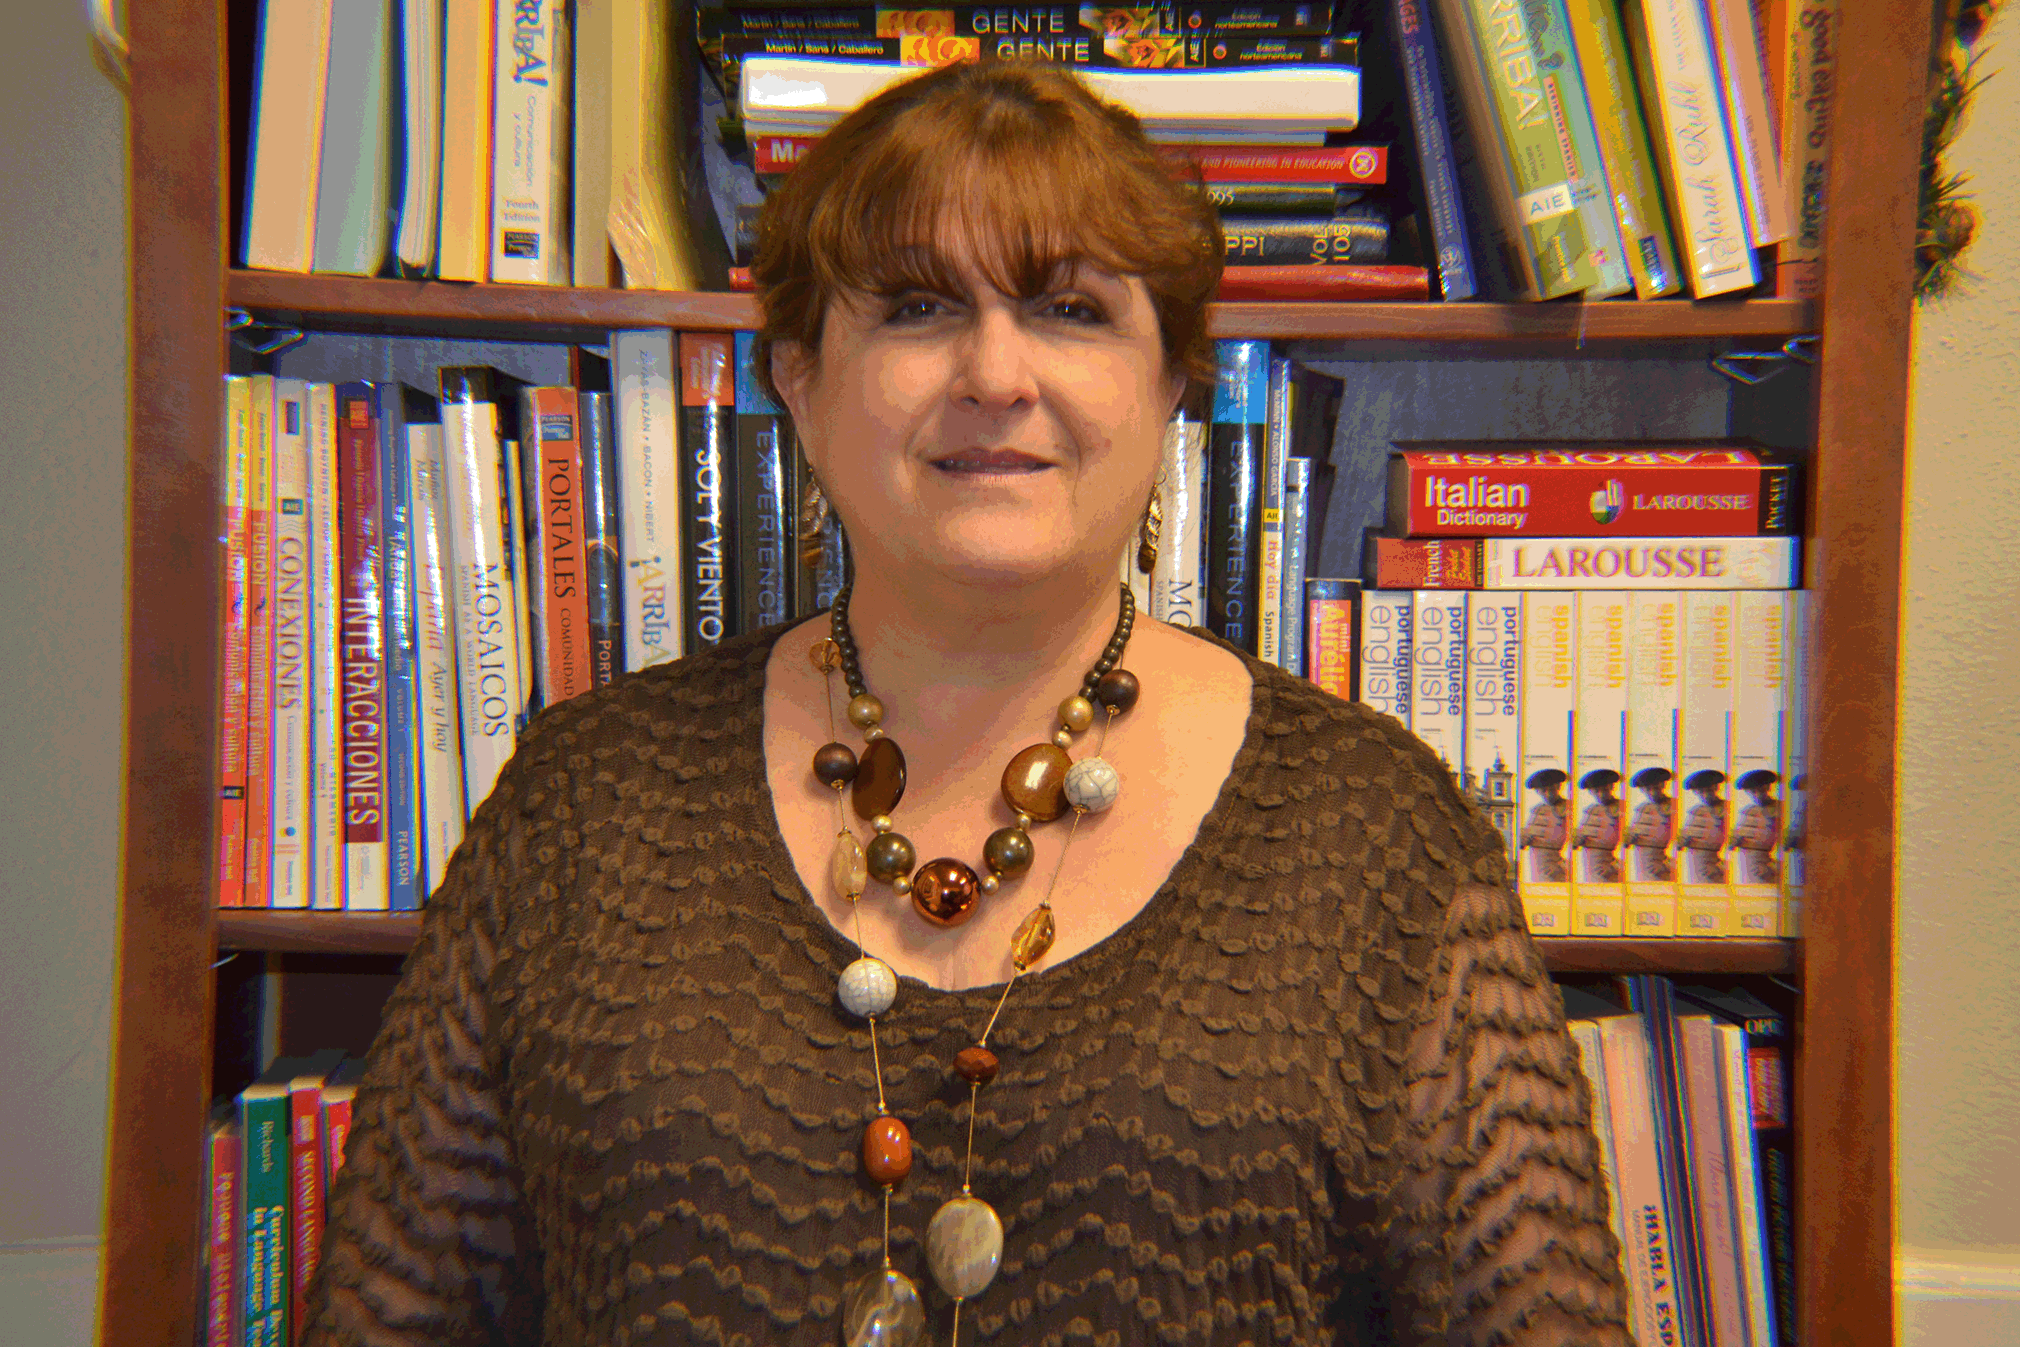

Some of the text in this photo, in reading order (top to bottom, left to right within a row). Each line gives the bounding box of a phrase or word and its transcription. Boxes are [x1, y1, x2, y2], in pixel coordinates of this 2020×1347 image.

[837, 42, 884, 55] Caballero
[972, 11, 1065, 34] GENTE
[996, 39, 1089, 62] GENTE
[1239, 50, 1303, 61] norteamericana
[1293, 157, 1345, 171] EDUCATION
[503, 211, 541, 224] Edition
[505, 199, 540, 211] Fourth
[1530, 193, 1565, 216] AIE
[695, 449, 722, 504] SOL
[1424, 475, 1529, 508] Italian
[1632, 494, 1750, 512] LAROUSSE
[1765, 475, 1784, 530] POCKET
[547, 458, 576, 599] PORTALES
[644, 500, 655, 543] NIBERT
[755, 430, 777, 628] EXPERIENCE
[1224, 439, 1249, 640] EXPERIENCE
[1437, 508, 1527, 531] Dictionary
[1264, 540, 1279, 570] Hoy
[1422, 540, 1442, 588] French
[1511, 547, 1726, 579] LAROUSSE
[697, 536, 724, 641] VIENTO
[1287, 564, 1299, 615] Language
[275, 536, 304, 711] CONEXIONES
[472, 562, 510, 738] MOSAICOS
[1262, 610, 1275, 659] Spanish
[1340, 623, 1351, 653] mini
[1548, 604, 1569, 689] spanish
[1601, 604, 1622, 689] spanish
[1654, 602, 1675, 687] spanish
[559, 607, 575, 697] COMUNIDAD
[1362, 604, 1397, 713] english
[1392, 605, 1412, 715] portuguese
[1414, 606, 1449, 717] english
[1445, 606, 1465, 716] portuguese
[1469, 606, 1504, 717] english
[1499, 606, 1521, 717] portuguese
[430, 661, 449, 705] Ayer
[342, 598, 382, 827] INTERACCIONES
[431, 721, 450, 753] hoy
[398, 829, 410, 886] PEARSON
[260, 1121, 275, 1173] Richards
[301, 1150, 315, 1207] SECOND
[250, 1230, 267, 1312] Language
[268, 1206, 285, 1305] Curriculum
